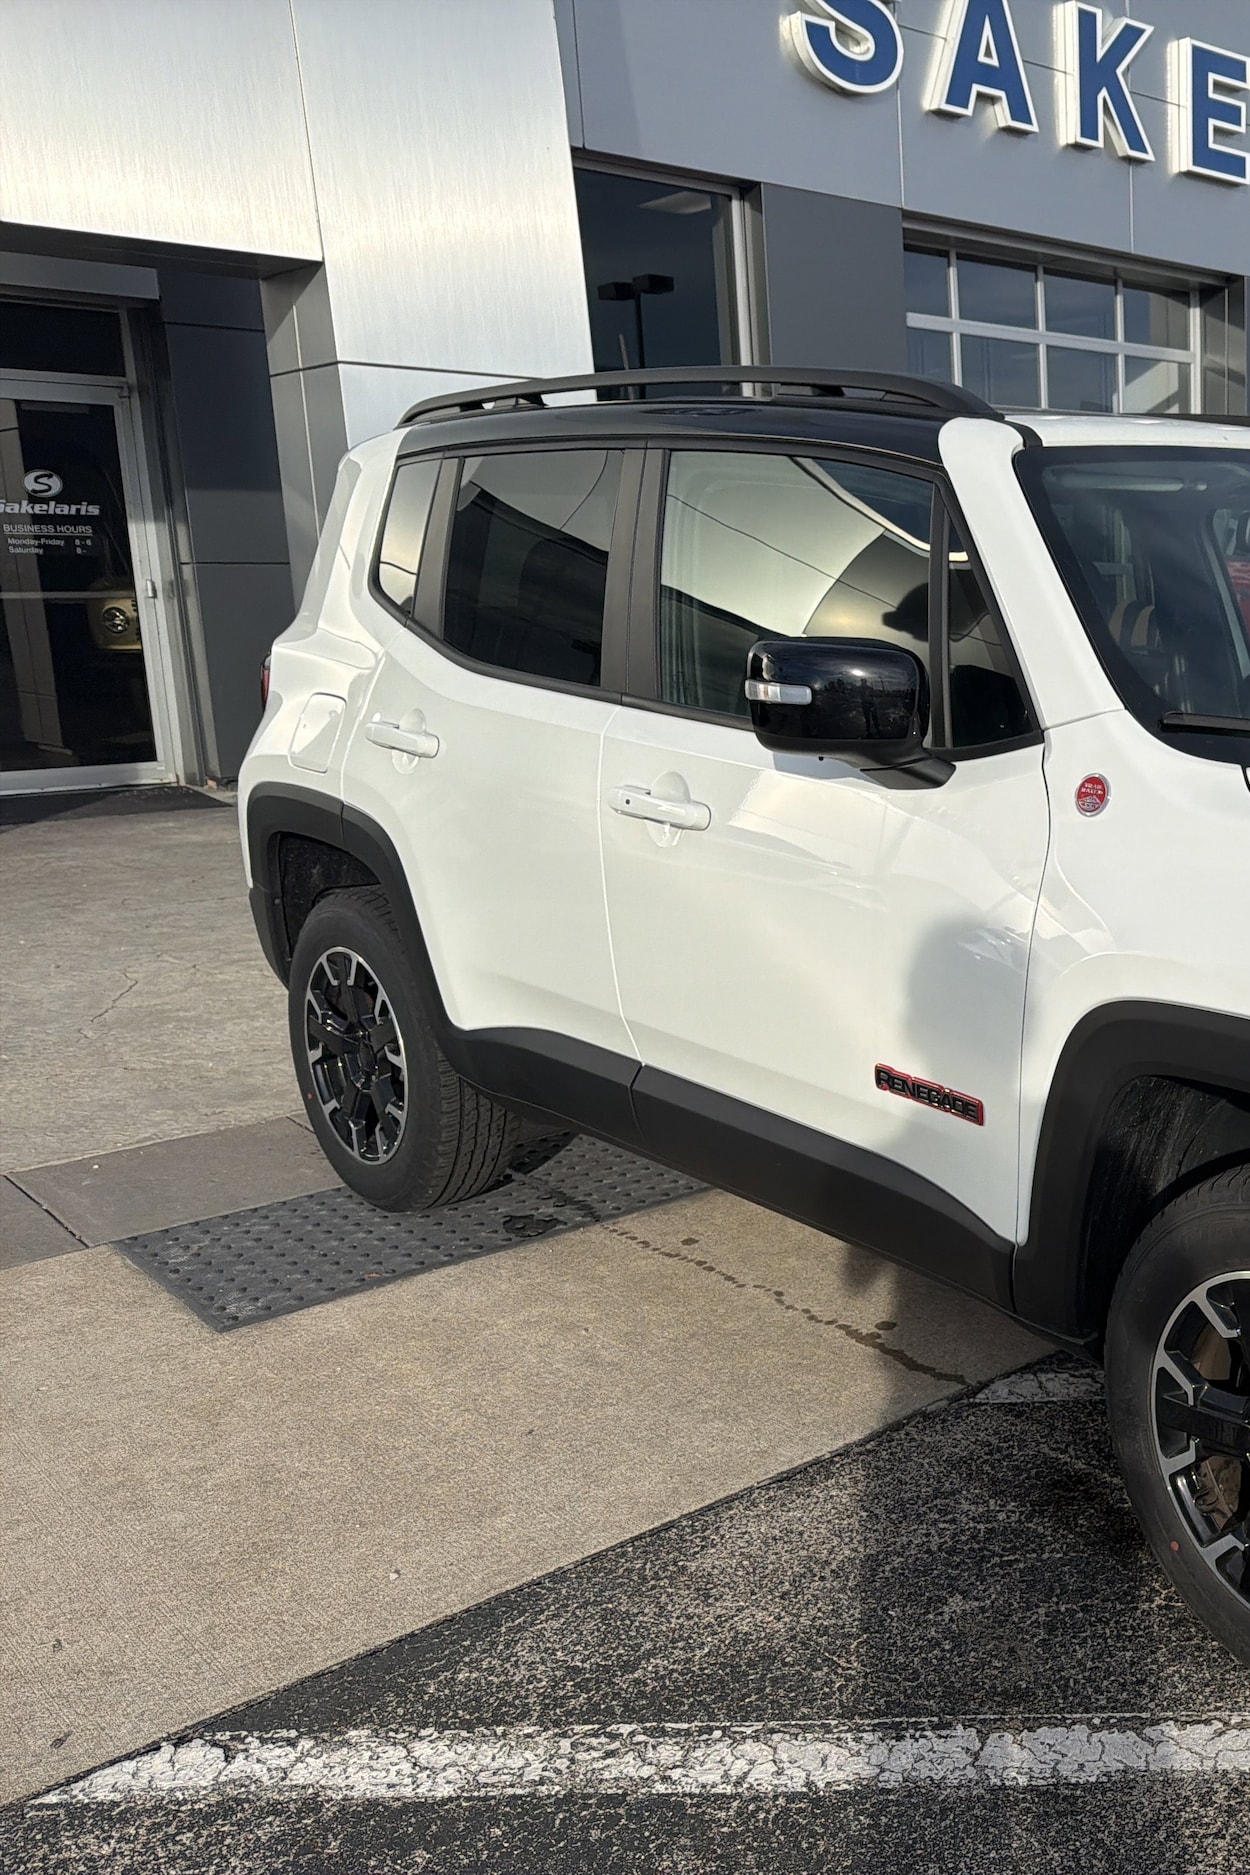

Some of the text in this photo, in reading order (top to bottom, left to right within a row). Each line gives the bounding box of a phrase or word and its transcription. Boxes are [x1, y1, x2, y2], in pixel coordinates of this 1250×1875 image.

[3, 524, 92, 533] BUSINESS HOURS
[7, 538, 64, 546] Monday-Friday
[8, 546, 43, 554] Saturday
[875, 1063, 984, 1126] RENEGADE
